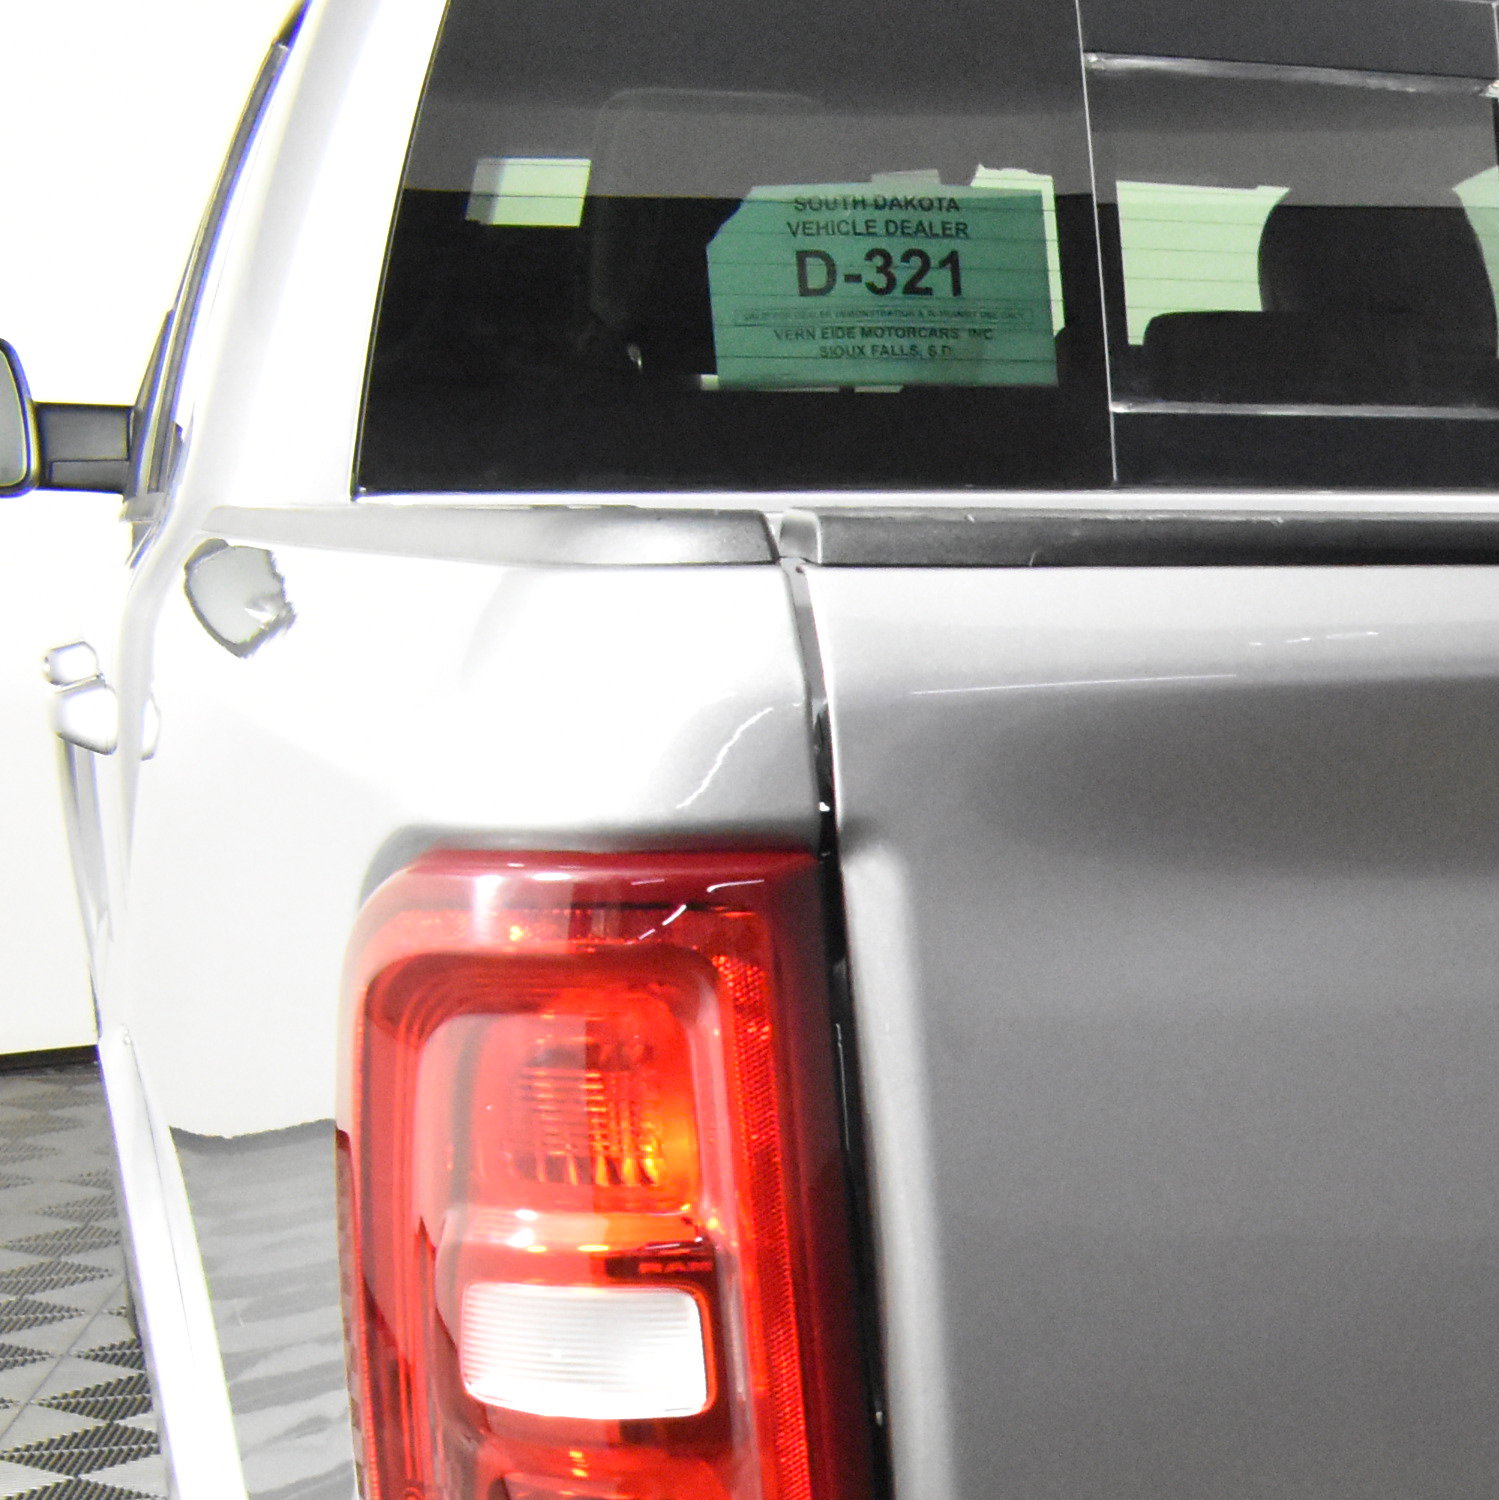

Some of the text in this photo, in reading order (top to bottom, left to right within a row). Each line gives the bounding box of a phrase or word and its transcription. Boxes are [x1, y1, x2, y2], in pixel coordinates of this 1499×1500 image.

[793, 195, 961, 212] SOUTH DAKOTA
[786, 219, 970, 238] VEHICLE DEALER
[795, 247, 962, 297] D-321
[773, 327, 817, 341] VERN
[821, 326, 857, 340] EIDE
[819, 344, 866, 359] SIOUX
